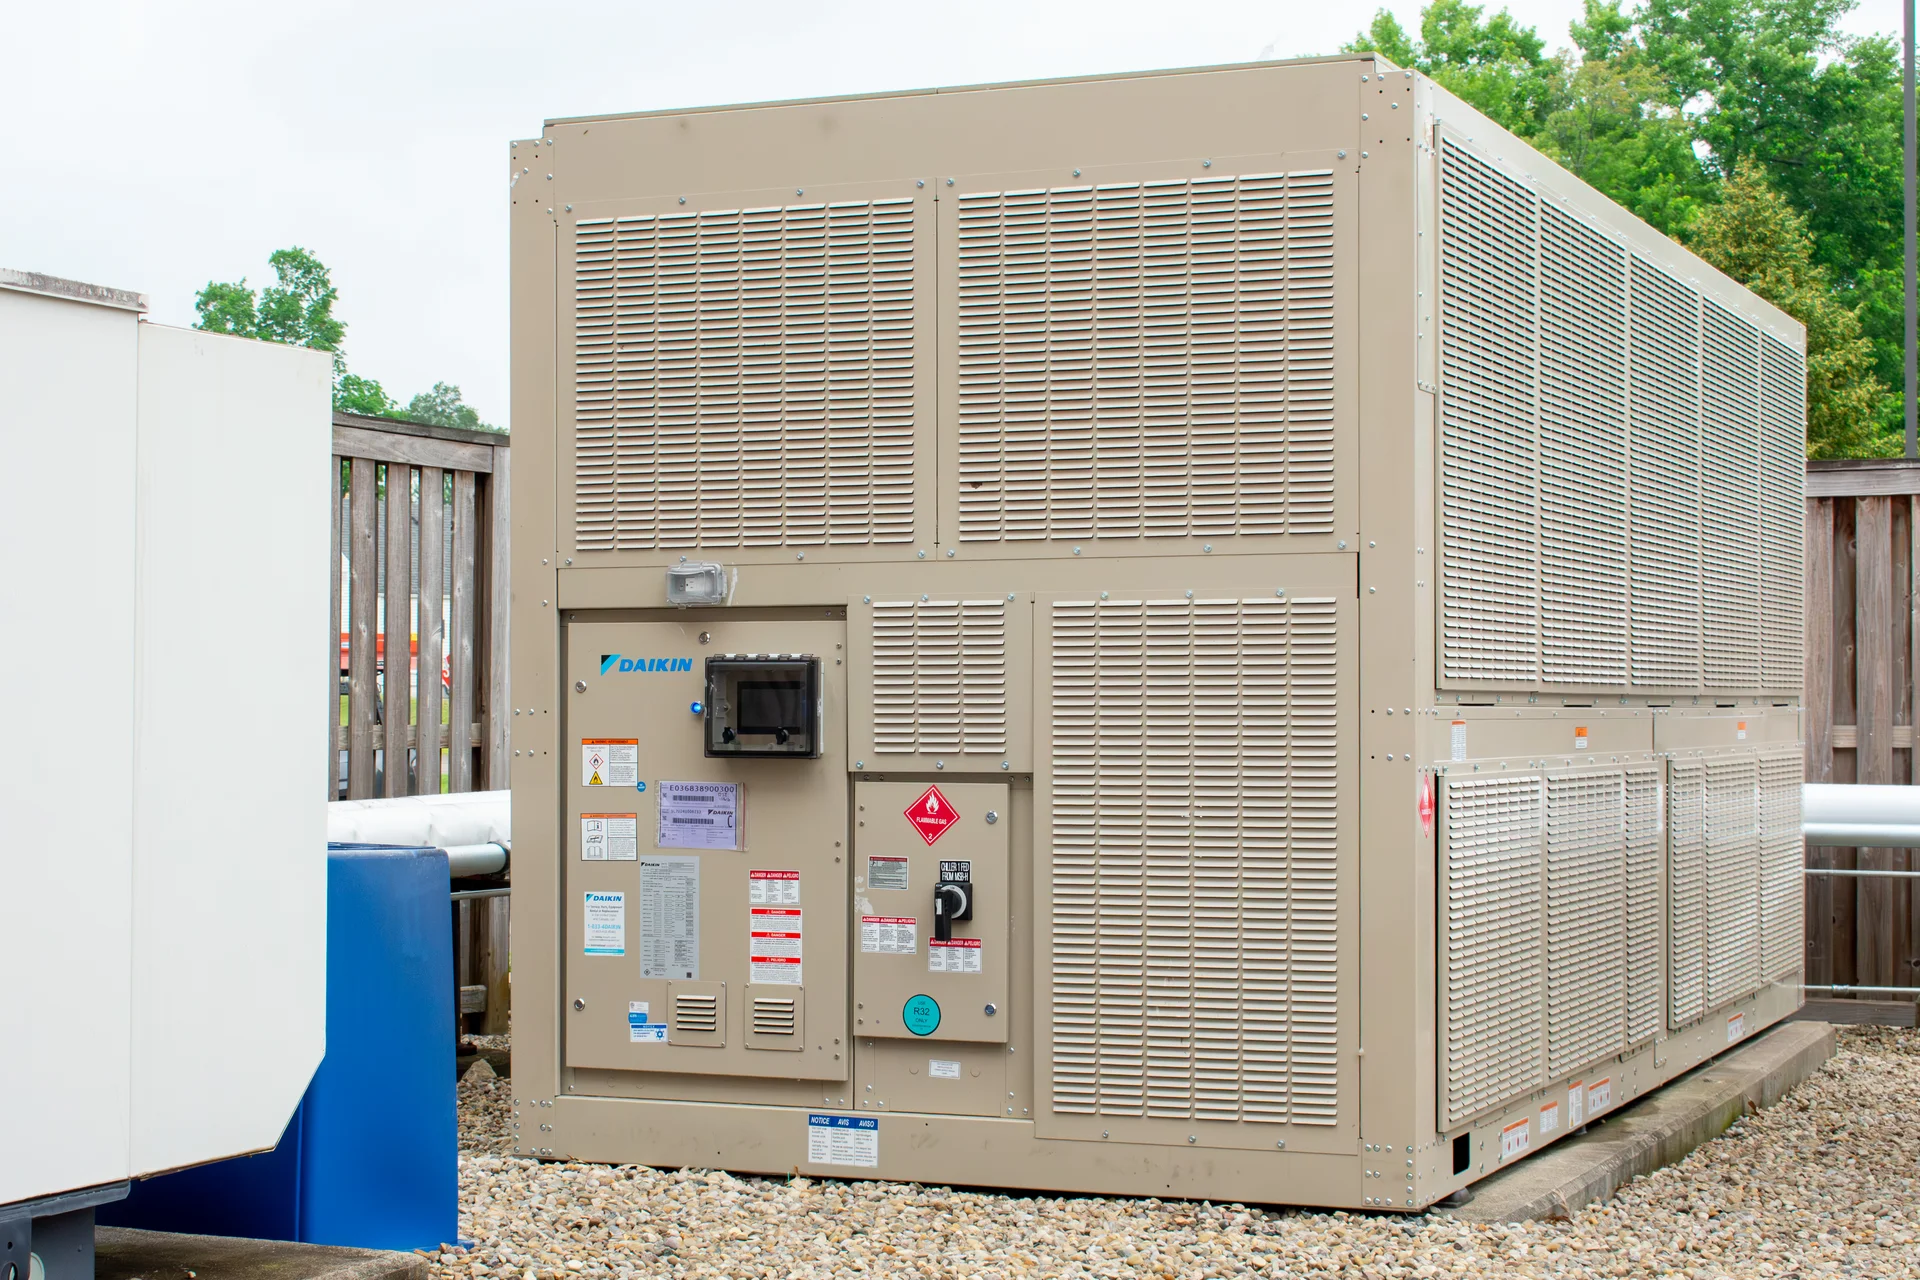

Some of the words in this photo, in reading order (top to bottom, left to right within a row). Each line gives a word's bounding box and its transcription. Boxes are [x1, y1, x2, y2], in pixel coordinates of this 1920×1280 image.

[619, 658, 692, 672] DAIKIN
[670, 784, 734, 792] E036838900300
[941, 862, 957, 871] CHILLER
[958, 863, 960, 871] 1
[961, 863, 969, 871] FED
[942, 872, 953, 881] FROM
[955, 872, 968, 881] MSB-H
[914, 1007, 930, 1016] R32
